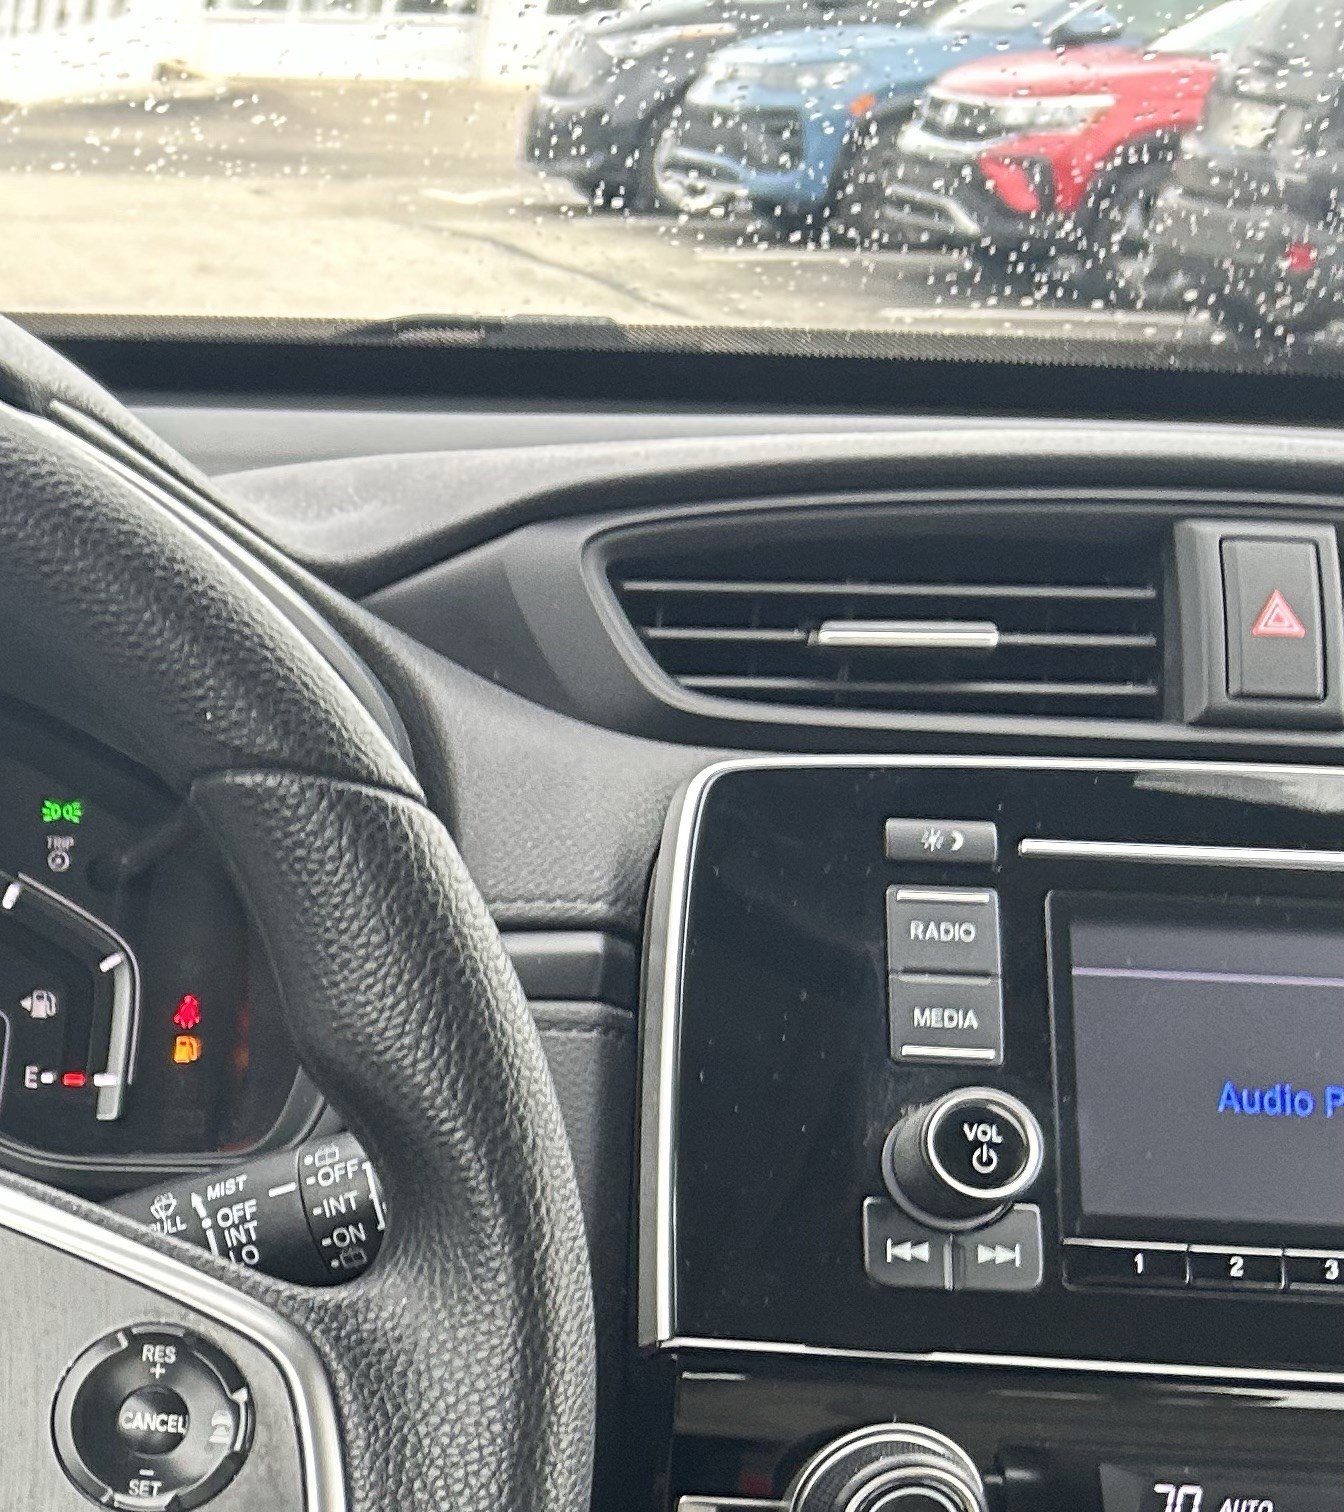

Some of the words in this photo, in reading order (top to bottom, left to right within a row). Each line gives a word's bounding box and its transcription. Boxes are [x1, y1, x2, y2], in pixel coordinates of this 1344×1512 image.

[910, 921, 976, 943] RADIO
[913, 1007, 979, 1030] MEDIA
[24, 1066, 38, 1089] E
[1217, 1081, 1314, 1118] Audio
[963, 1122, 1003, 1144] VOL
[317, 1157, 359, 1188] OFF
[206, 1174, 247, 1202] MIST
[216, 1199, 257, 1228] OFF
[323, 1189, 358, 1218] INT
[224, 1219, 258, 1248] INT
[332, 1222, 367, 1248] ON
[1134, 1254, 1144, 1275] 1
[1229, 1256, 1244, 1278] 2
[1324, 1255, 1340, 1280] 3
[142, 1344, 176, 1364] RES
[120, 1410, 187, 1434] CANCEL
[128, 1479, 162, 1498] SET
